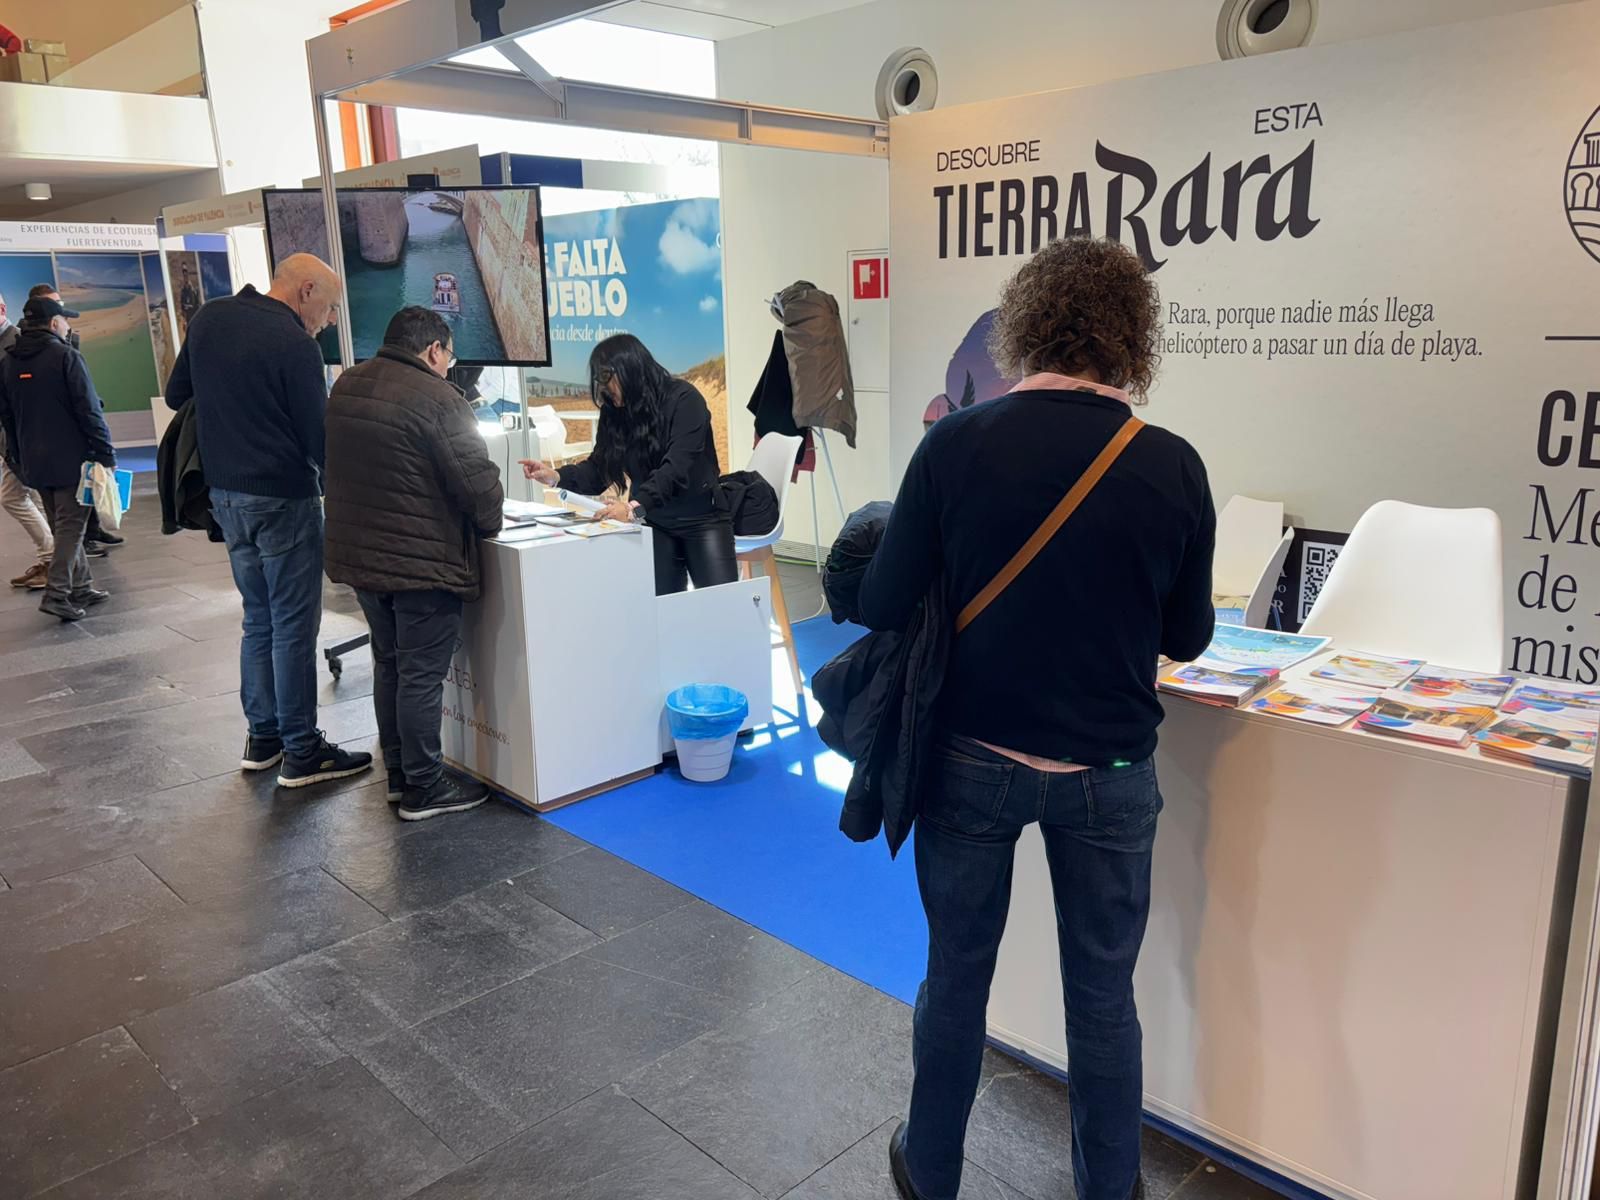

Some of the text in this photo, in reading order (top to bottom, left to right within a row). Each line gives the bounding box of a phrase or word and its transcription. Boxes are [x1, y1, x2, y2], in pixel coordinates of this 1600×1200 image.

[1254, 102, 1323, 135] ESTA
[936, 139, 1041, 172] DESCUBRE
[933, 138, 1321, 274] TIERRA Rara
[20, 224, 90, 235] EXPERIENCIAS
[93, 226, 105, 235] DE
[66, 238, 144, 248] FUERTEVENTURA
[553, 235, 628, 278] FALTA
[1168, 297, 1435, 330] Rara, porque nadie más llega
[566, 323, 594, 342] desde
[1252, 338, 1263, 355] a
[1267, 336, 1317, 360] pasar
[1323, 335, 1348, 356] un
[1354, 330, 1384, 356] día
[1391, 331, 1415, 356] de
[1421, 329, 1483, 361] playa.
[1517, 554, 1577, 613] de
